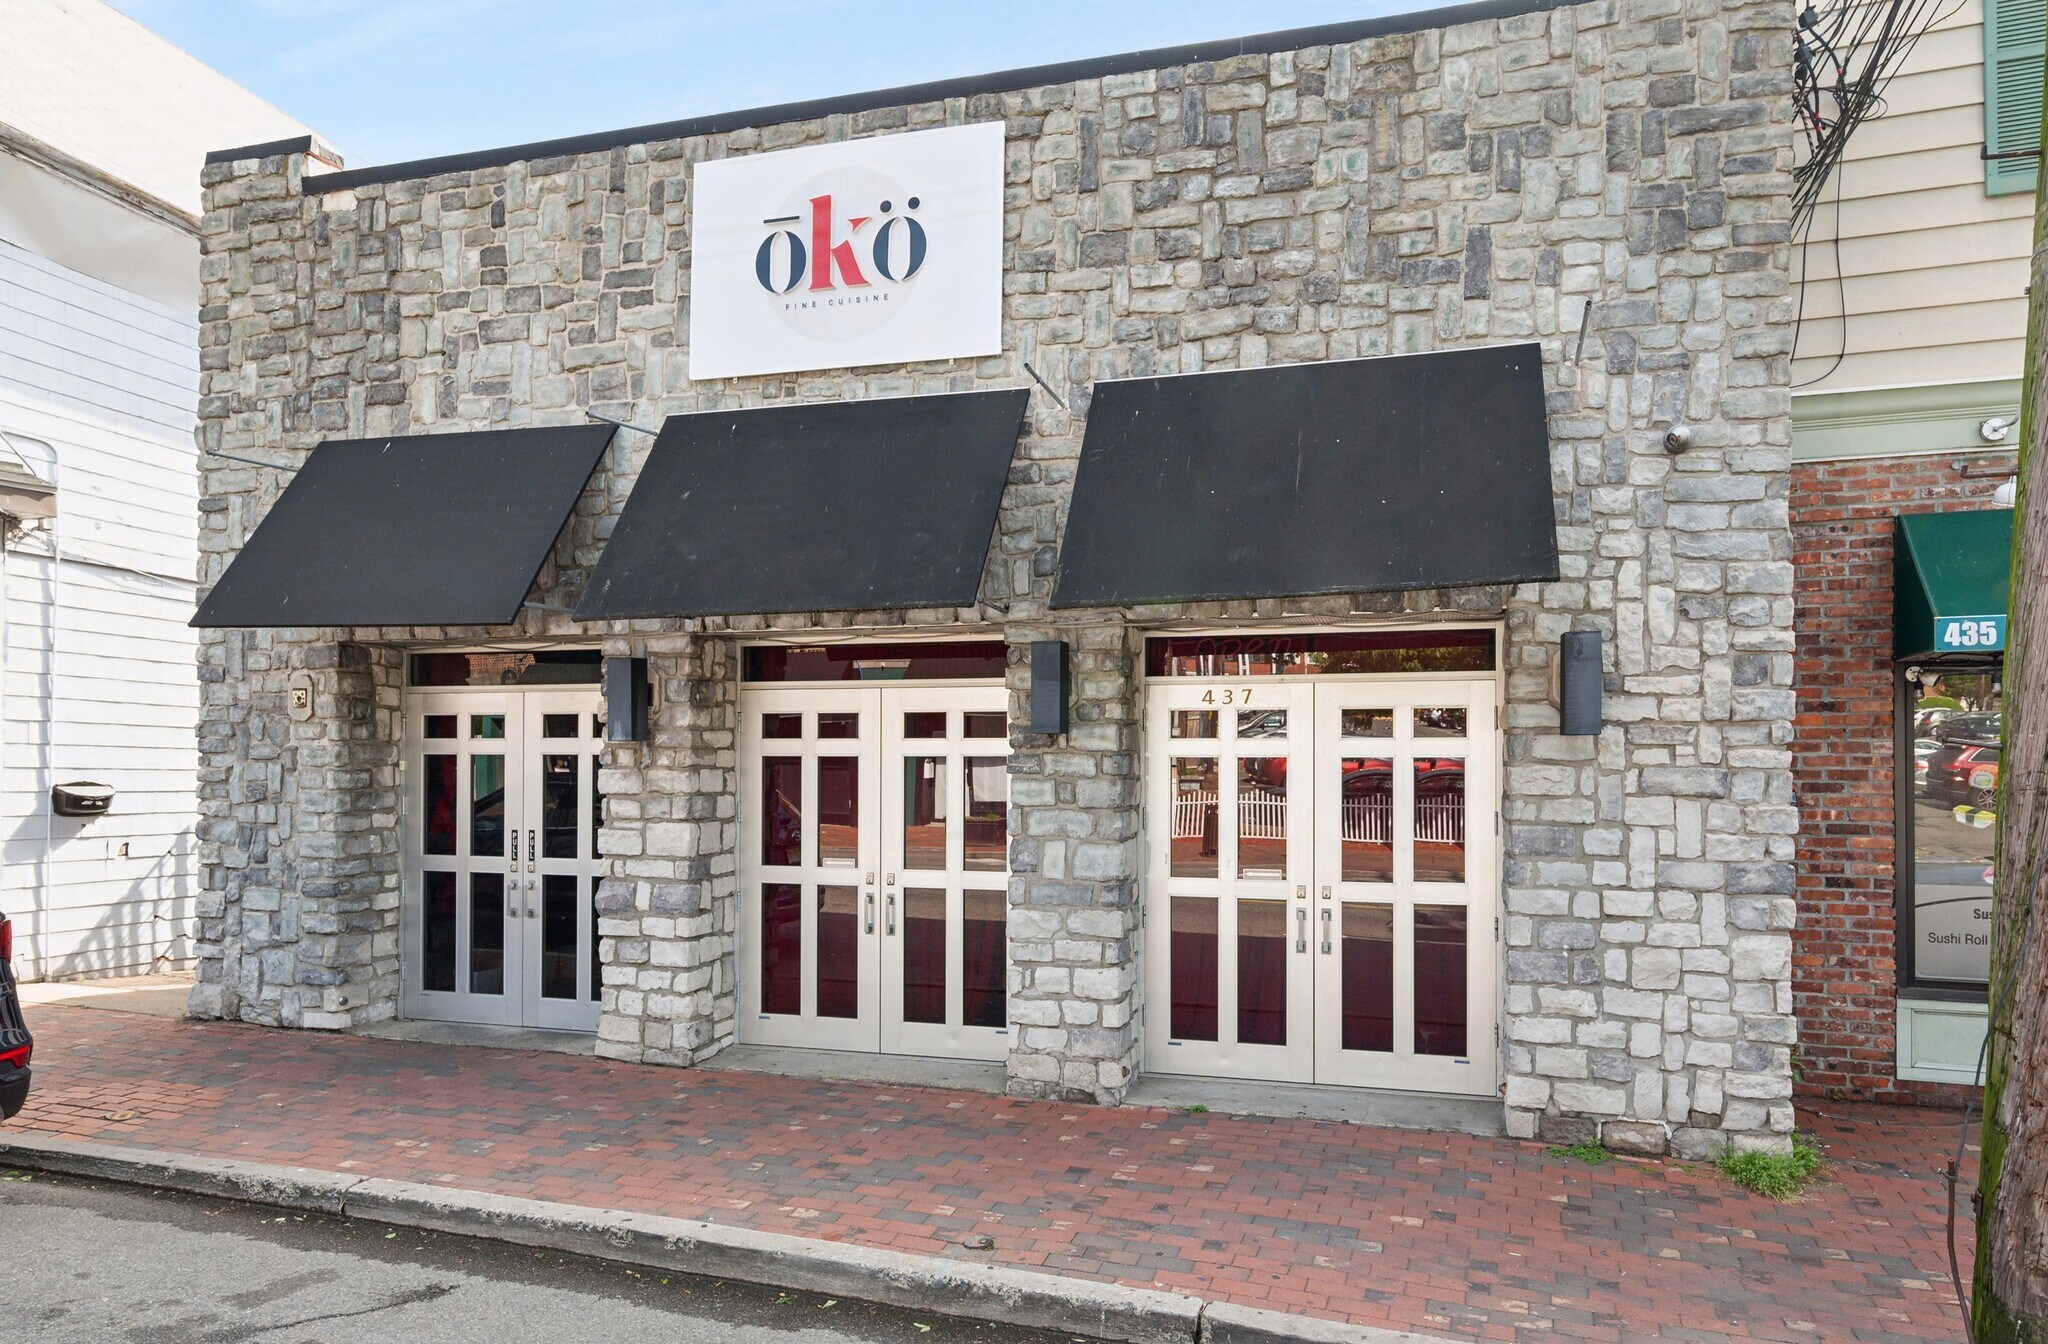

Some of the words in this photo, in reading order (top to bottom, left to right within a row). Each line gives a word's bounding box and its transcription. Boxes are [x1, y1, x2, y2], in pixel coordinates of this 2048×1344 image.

[785, 300, 817, 311] FINE
[828, 293, 889, 306] CUISINE
[1944, 620, 1997, 646] 435
[1201, 688, 1253, 705] 437
[1928, 932, 1961, 944] Sushi
[1965, 933, 1988, 946] Roll
